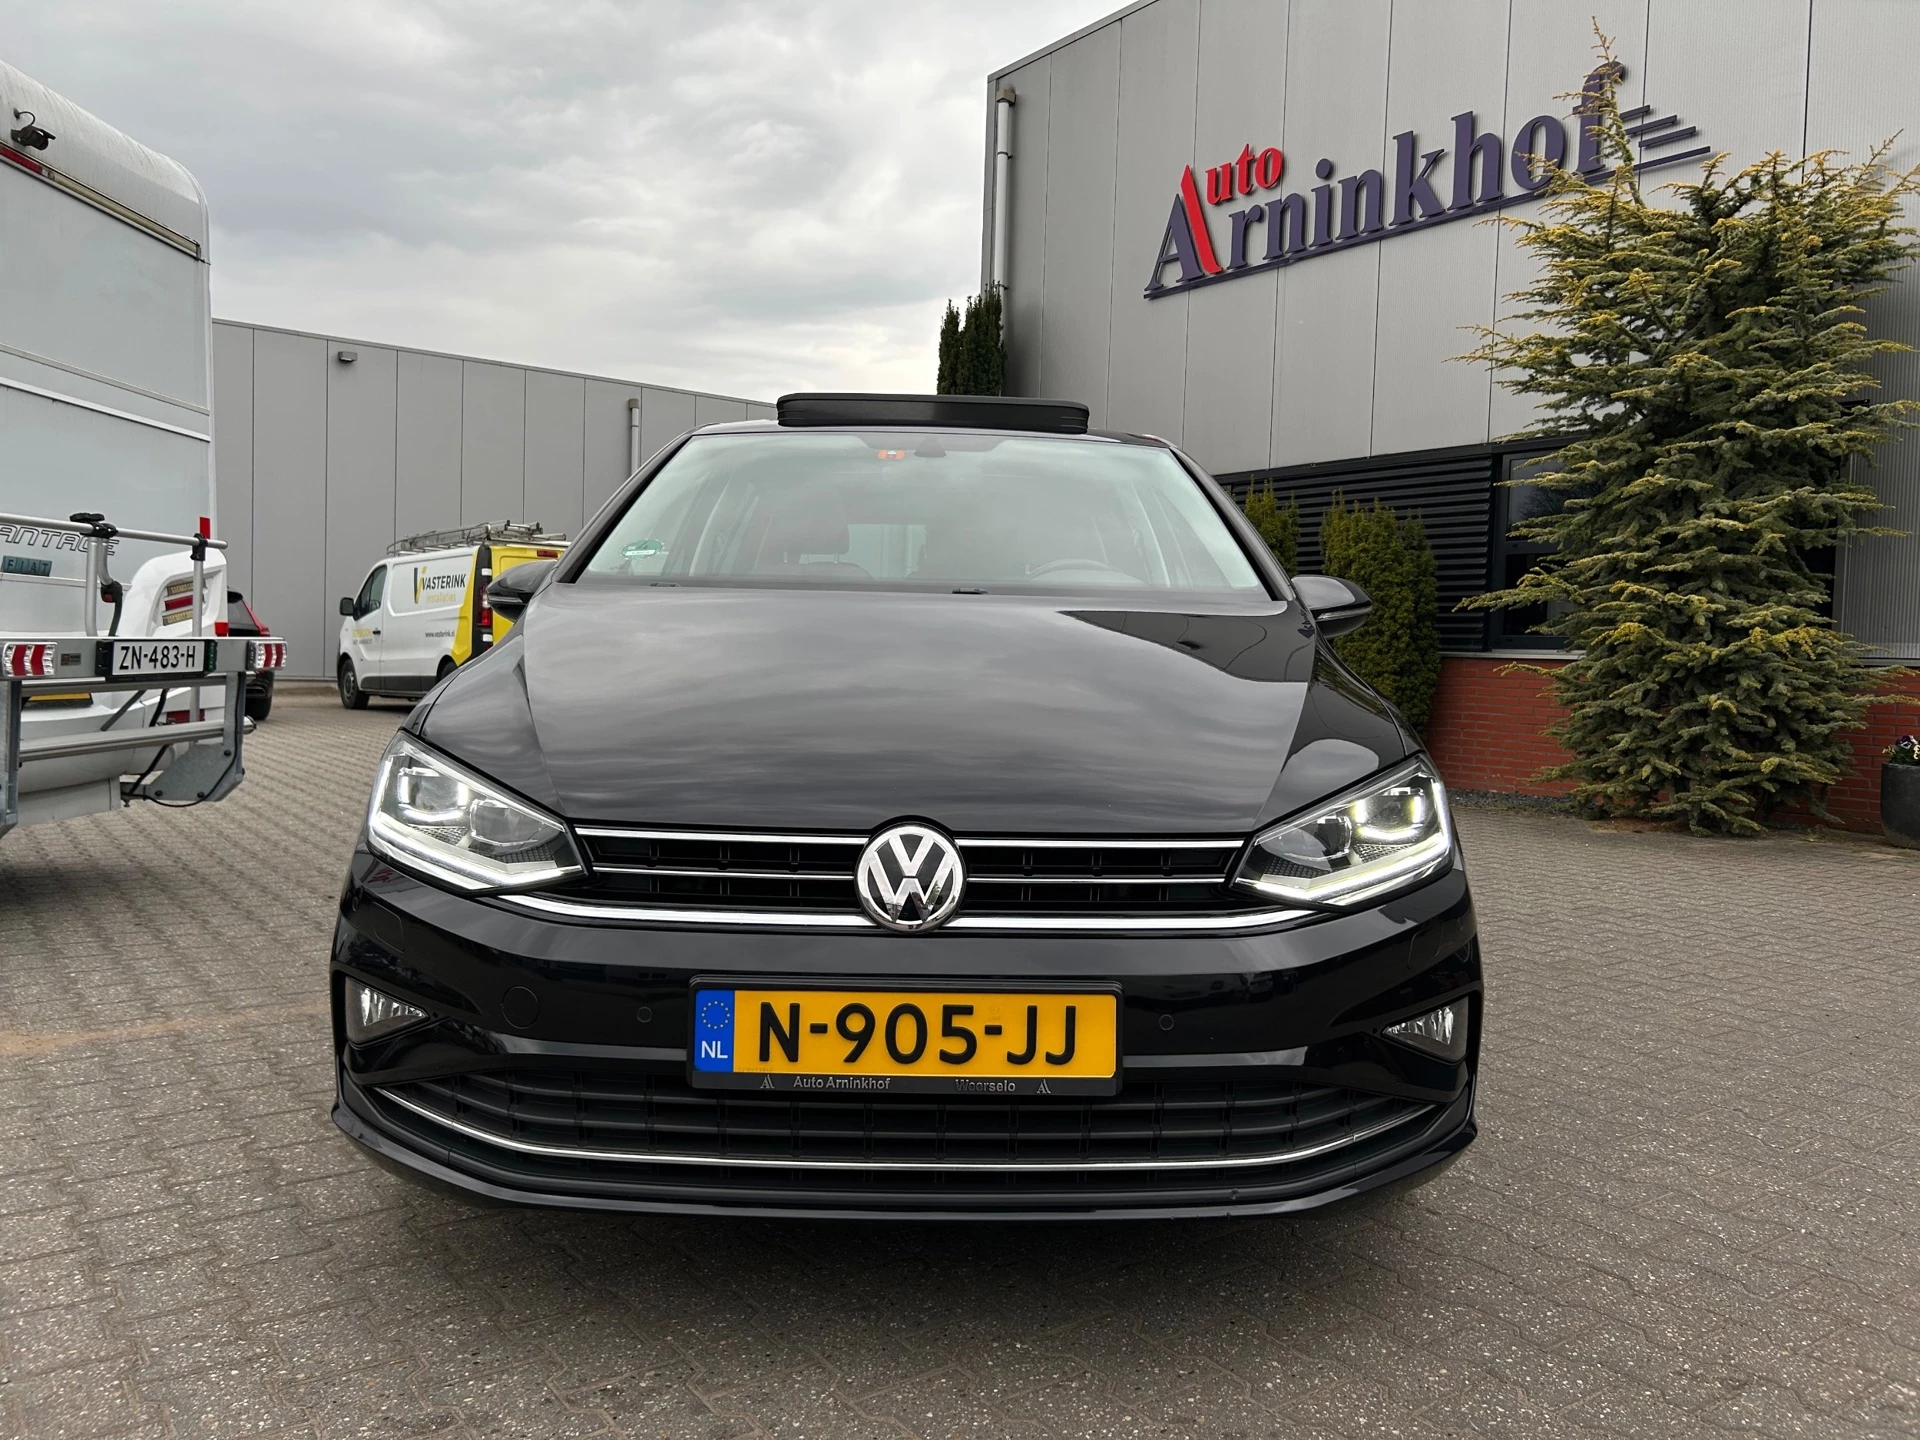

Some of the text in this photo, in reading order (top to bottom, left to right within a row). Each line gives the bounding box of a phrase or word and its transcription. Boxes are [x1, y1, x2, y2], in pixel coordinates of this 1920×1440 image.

[1143, 60, 1626, 292] Arninkhof
[7, 559, 49, 574] FIAT
[423, 573, 467, 590] VASTERINK
[119, 645, 196, 670] ZN-483-H
[758, 1001, 1077, 1066] N-905-JJ
[701, 1040, 728, 1059] NL
[793, 1076, 891, 1090] Auto Arninkhof
[955, 1079, 1016, 1092] Weerselo
